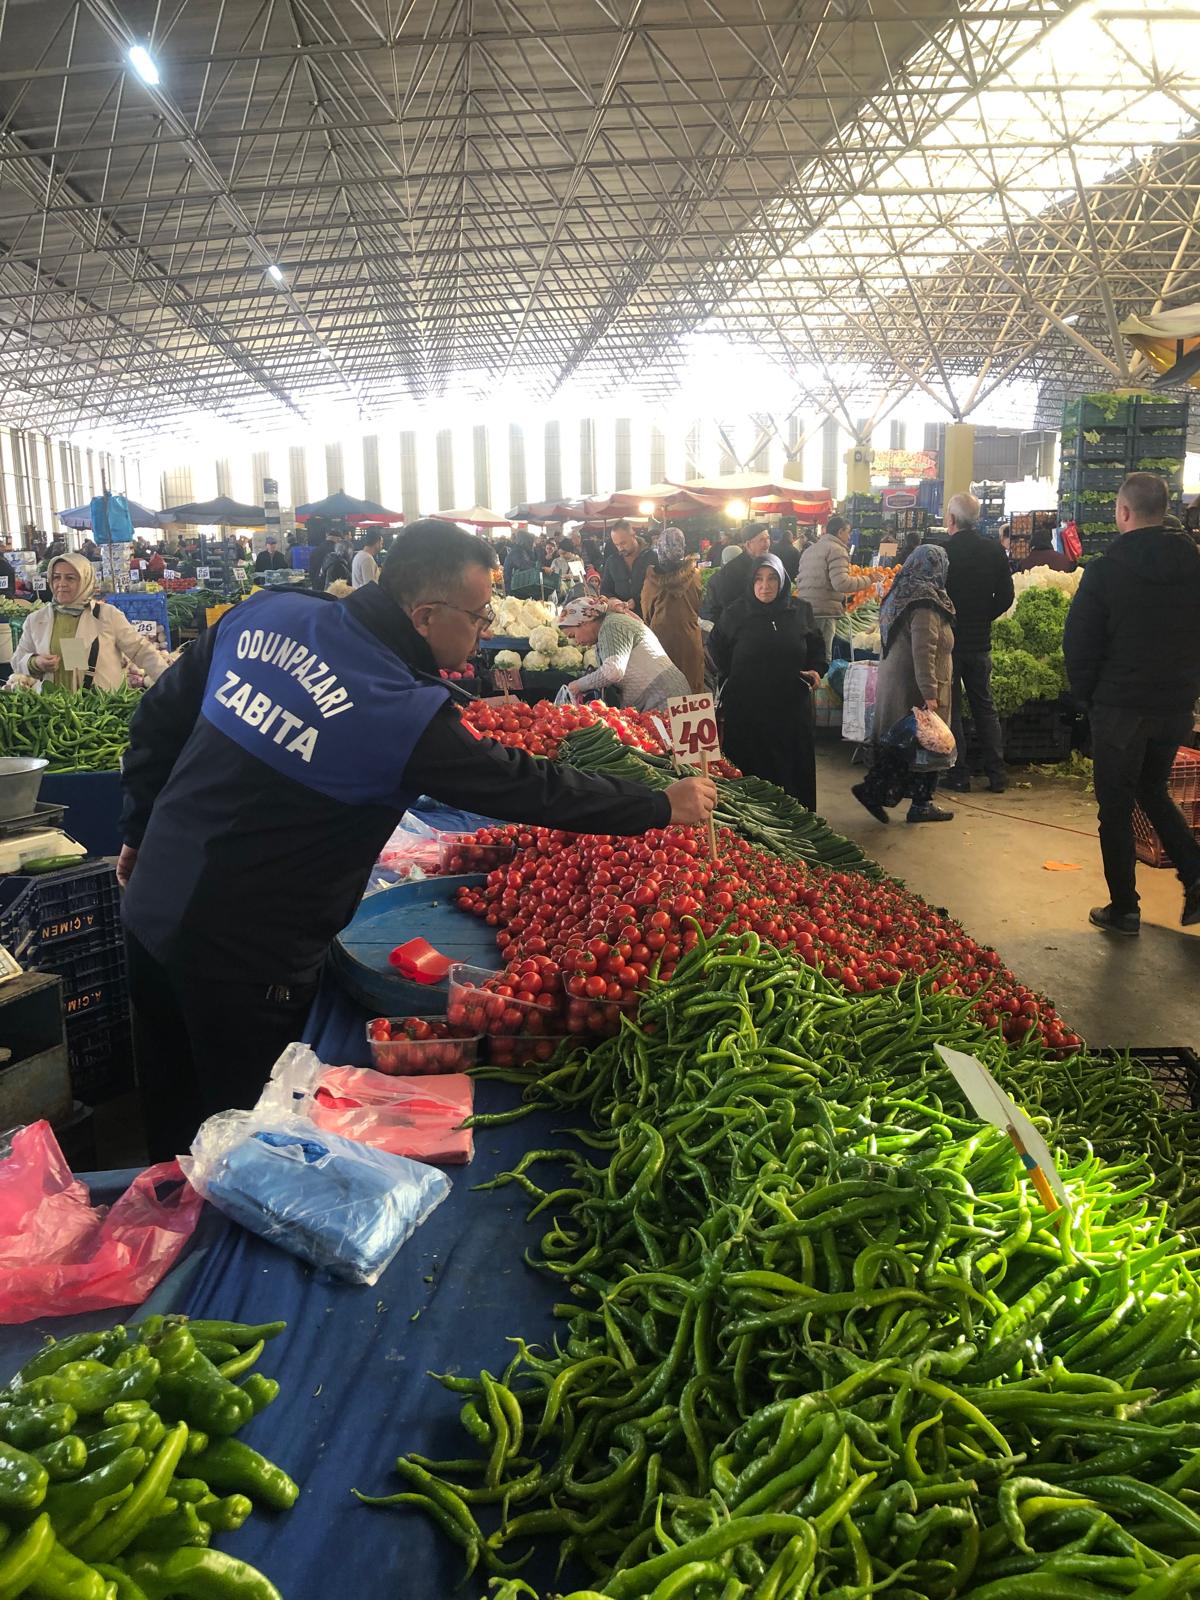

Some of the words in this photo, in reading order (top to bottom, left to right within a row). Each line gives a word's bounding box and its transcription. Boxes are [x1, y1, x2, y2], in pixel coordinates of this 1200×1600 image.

[214, 670, 319, 763] ZABITA
[237, 629, 354, 719] ODUNPAZARI
[679, 718, 717, 754] 40
